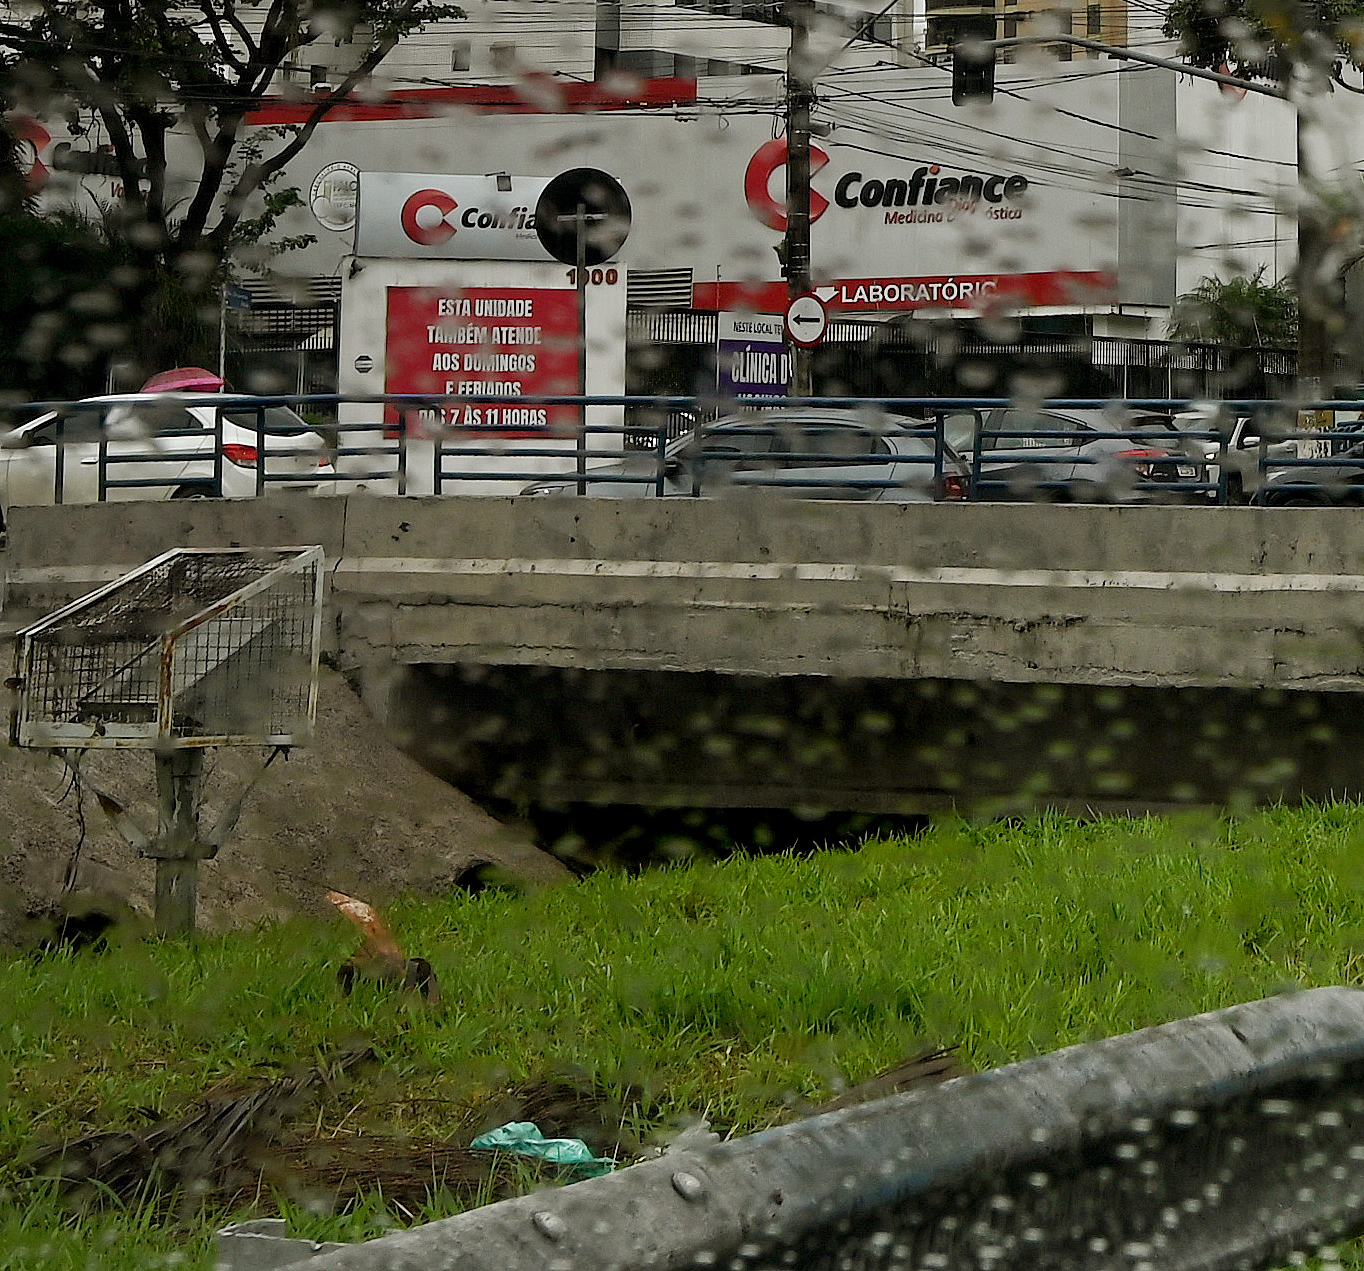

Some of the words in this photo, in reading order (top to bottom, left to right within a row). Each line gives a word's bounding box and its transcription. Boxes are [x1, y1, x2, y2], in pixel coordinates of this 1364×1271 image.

[834, 164, 1028, 209] Confiance
[461, 207, 538, 230] Confia
[884, 211, 943, 225] Medicina
[438, 299, 471, 317] ESTA
[475, 299, 533, 317] UNIDADE
[427, 323, 488, 345] TAMBÉM
[491, 326, 542, 345] ATENDE
[753, 322, 773, 334] LOCAL
[432, 353, 460, 371] AOS
[463, 354, 536, 372] DOMINGOS
[731, 344, 777, 384] CLÍNICA
[780, 354, 788, 385] D
[445, 381, 454, 396] E
[458, 381, 522, 397] FERIADOS
[450, 409, 461, 425] 7
[463, 405, 482, 425] ÀS
[485, 410, 500, 425] 11
[502, 409, 548, 425] HORAS
